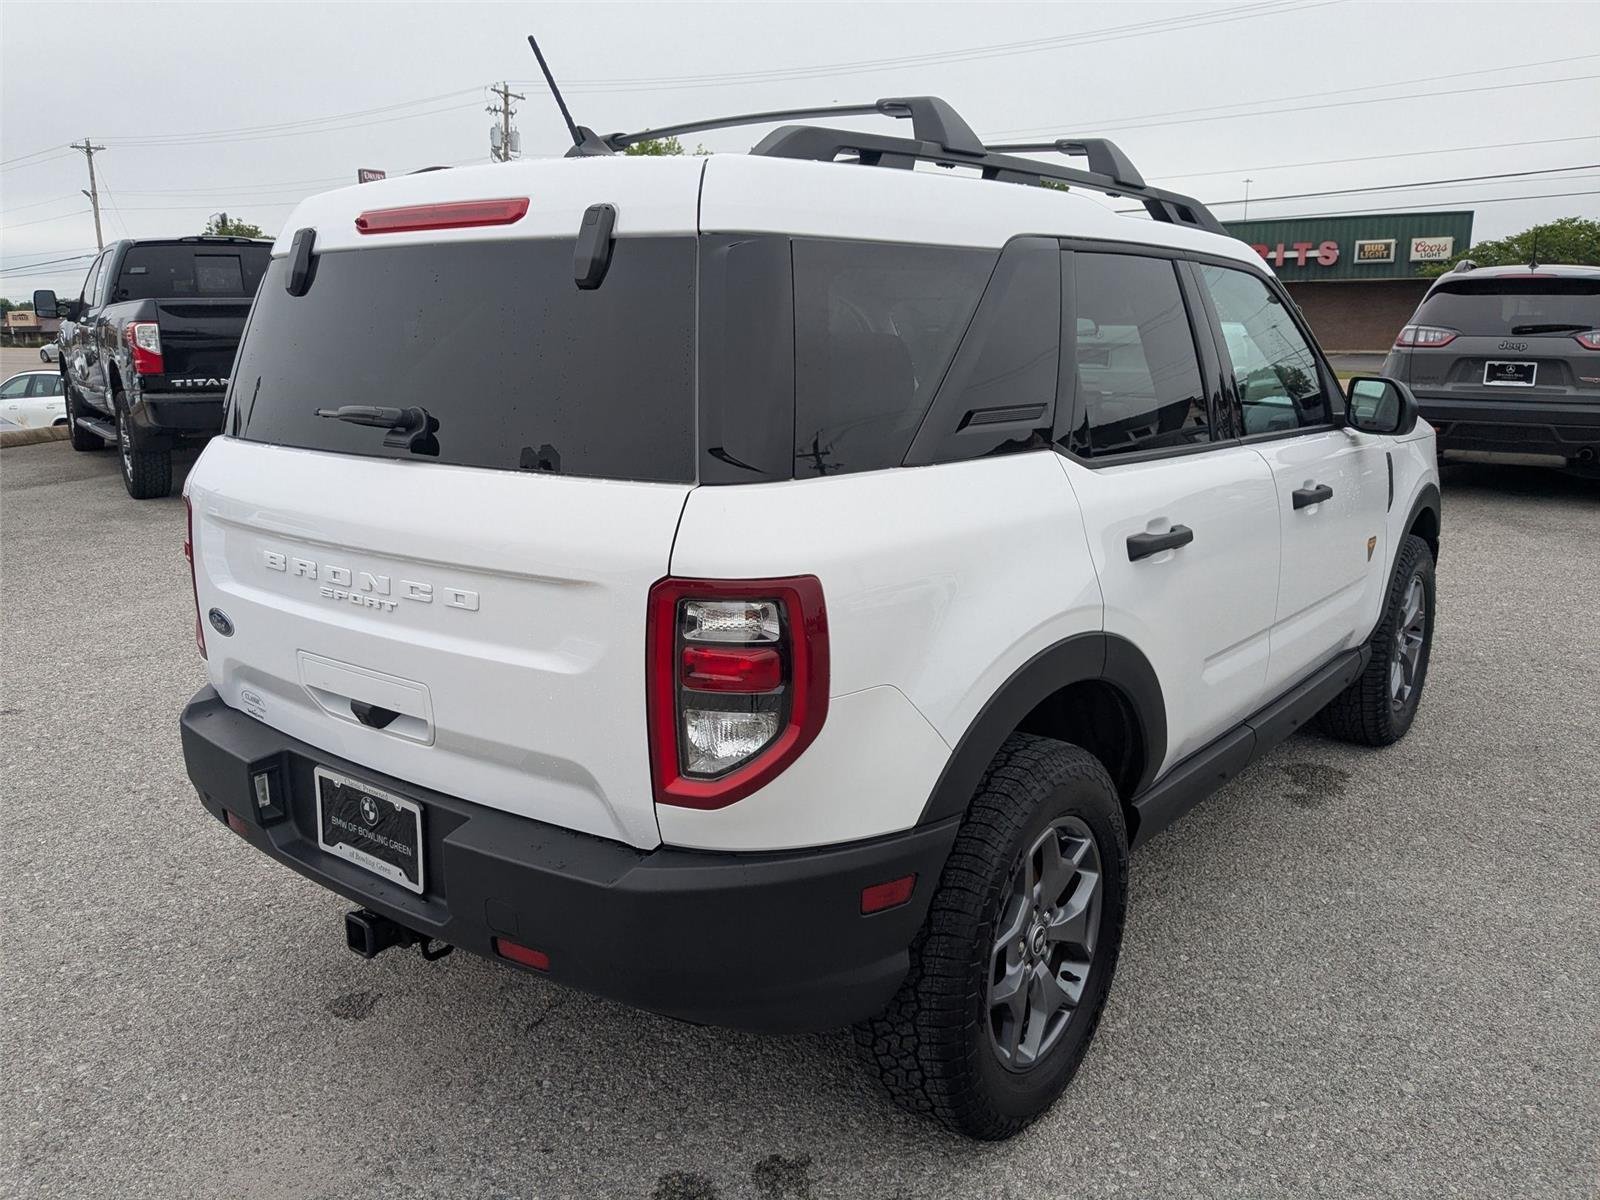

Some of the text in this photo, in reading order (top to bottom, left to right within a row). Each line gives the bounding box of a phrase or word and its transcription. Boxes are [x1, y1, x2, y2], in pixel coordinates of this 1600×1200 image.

[1364, 243, 1386, 252] BUD
[1414, 241, 1448, 253] Coors
[1360, 250, 1389, 259] LIGHT
[1420, 251, 1442, 259] LIGHT
[1498, 340, 1528, 352] Jeep
[263, 550, 480, 612] BRONCO
[319, 586, 398, 613] SPORT
[331, 815, 412, 857] BMW OF BOWLING GREEN
